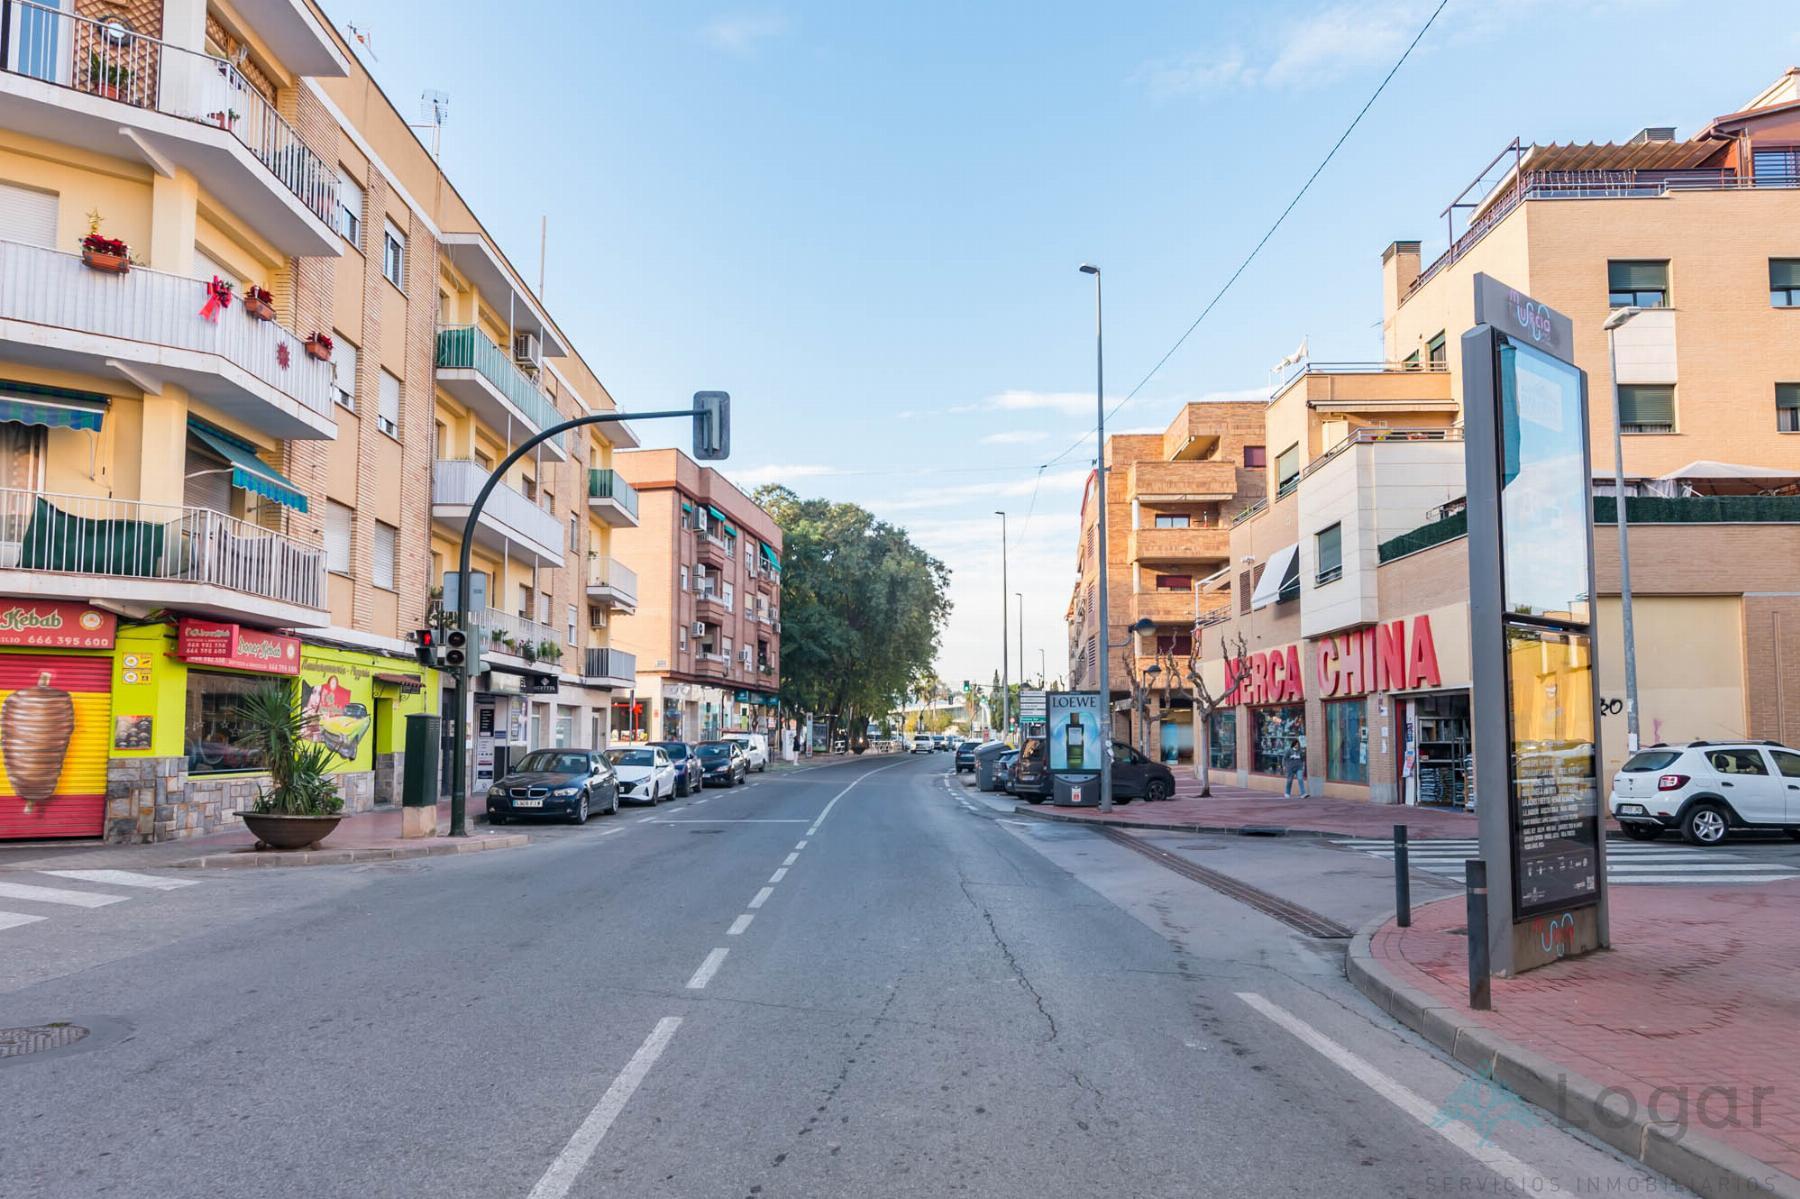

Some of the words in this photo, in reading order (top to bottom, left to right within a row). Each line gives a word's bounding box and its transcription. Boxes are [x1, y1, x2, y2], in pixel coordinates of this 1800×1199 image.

[1, 606, 63, 631] Kebab
[28, 635, 52, 644] 666
[57, 637, 80, 645] 395
[84, 638, 108, 646] 600
[1224, 645, 1305, 706] MERCA
[1317, 615, 1441, 696] CHINA
[1052, 696, 1096, 708] LOEWE
